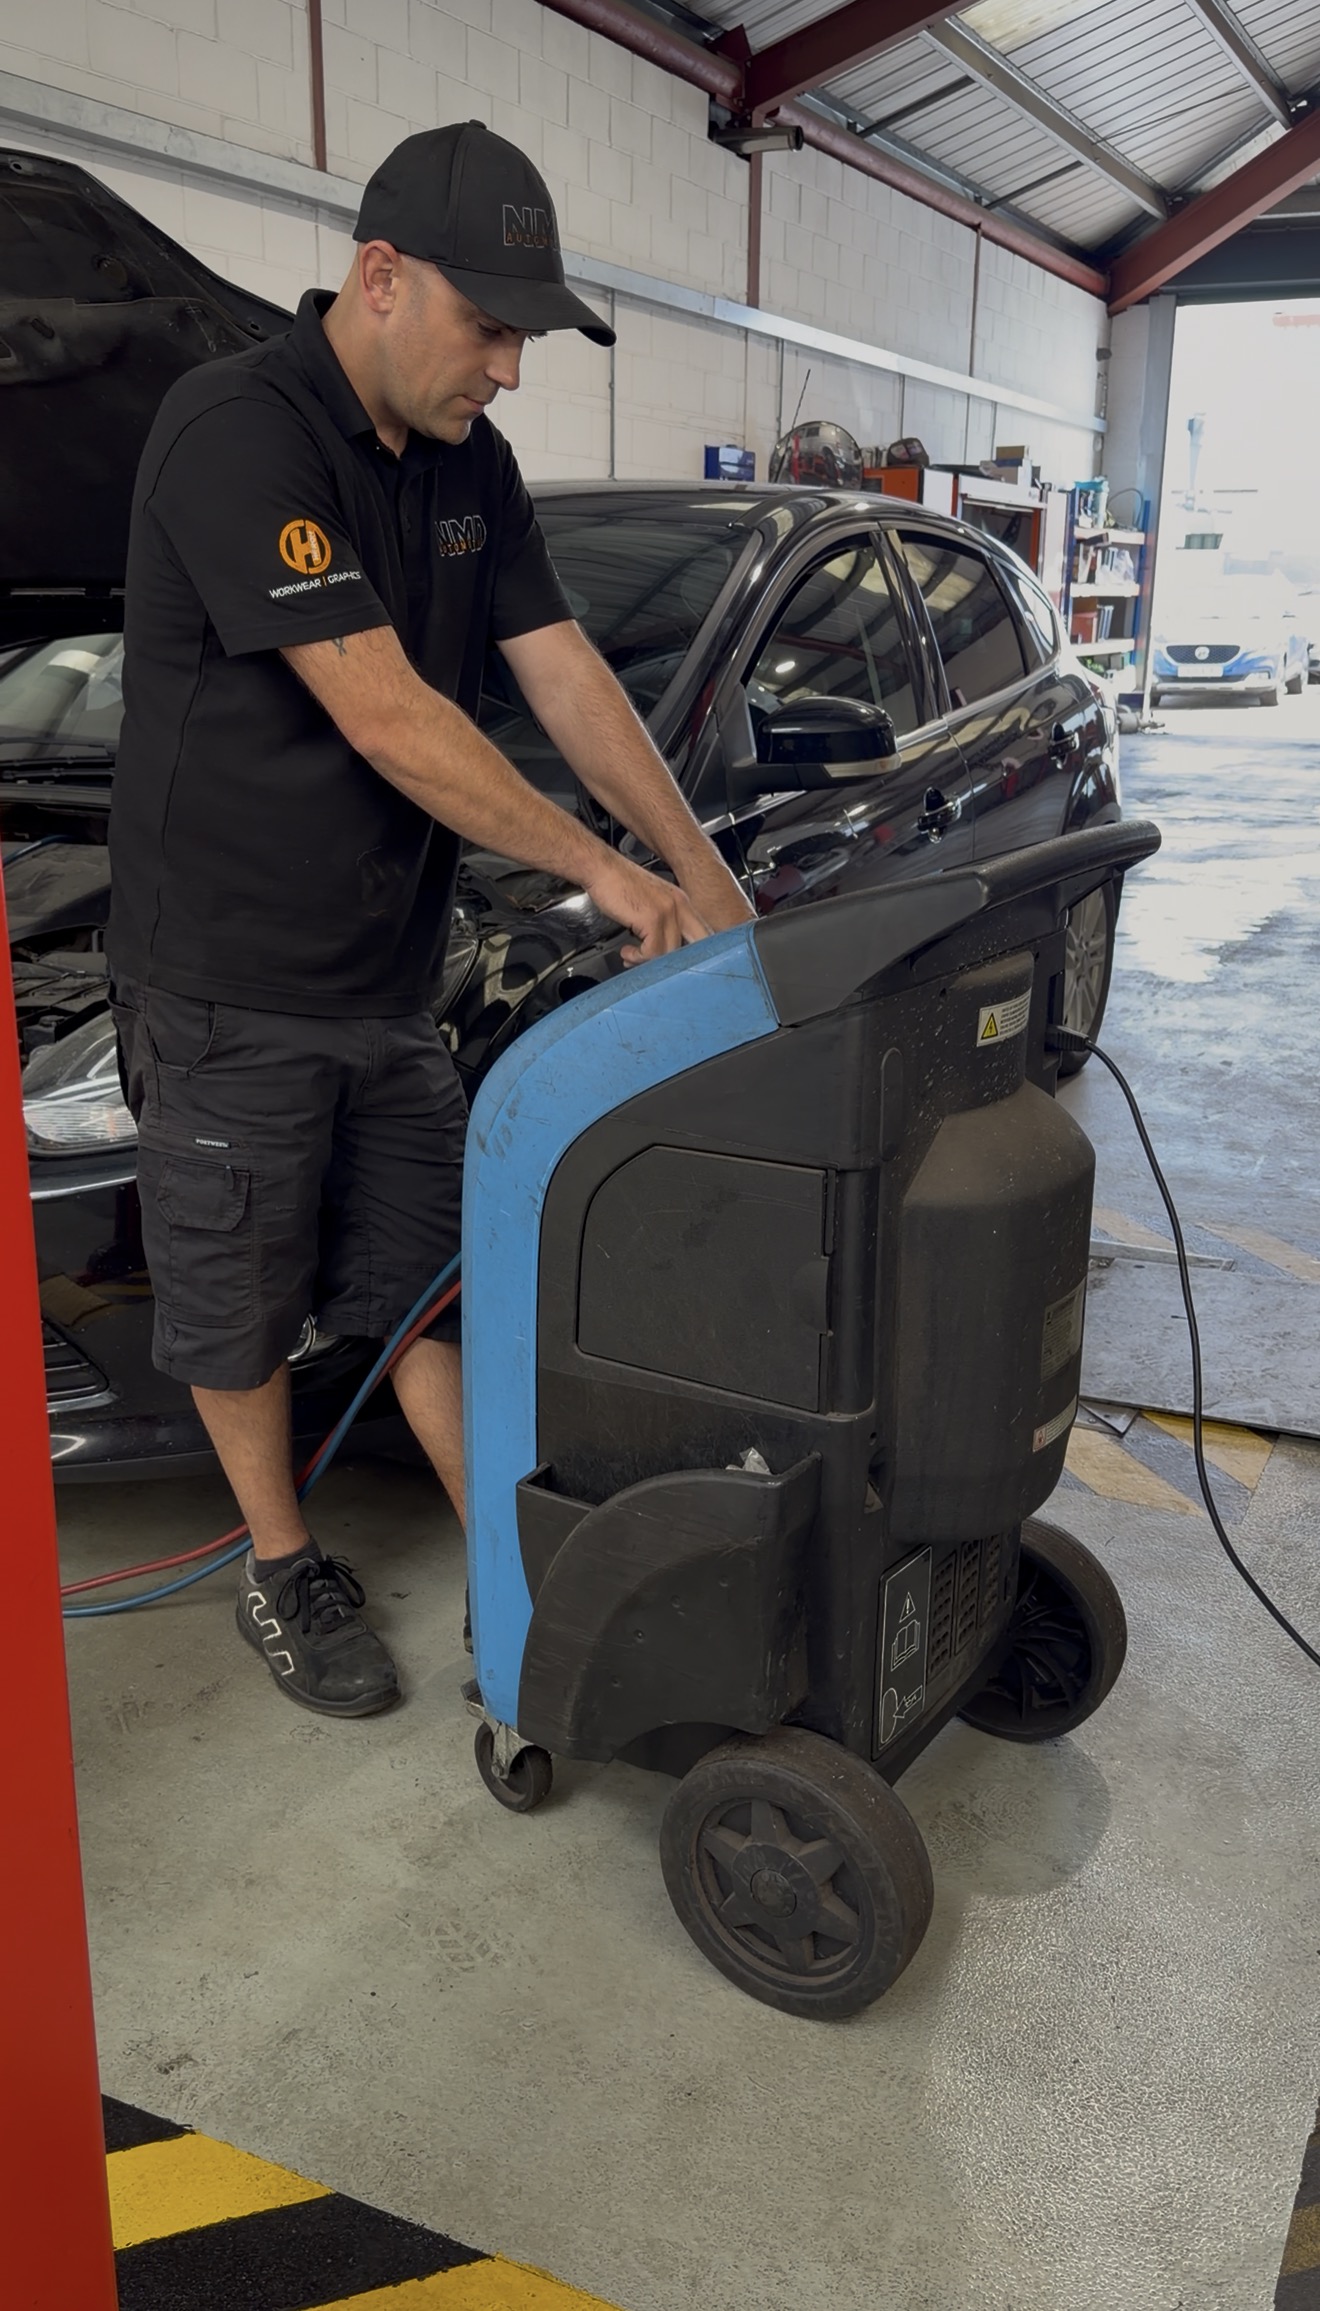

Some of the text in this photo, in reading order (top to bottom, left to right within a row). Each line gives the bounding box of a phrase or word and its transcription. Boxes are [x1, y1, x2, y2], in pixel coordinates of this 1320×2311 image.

[434, 514, 487, 557] NMD
[269, 571, 362, 599] WORKWEAR GRAPHICS
